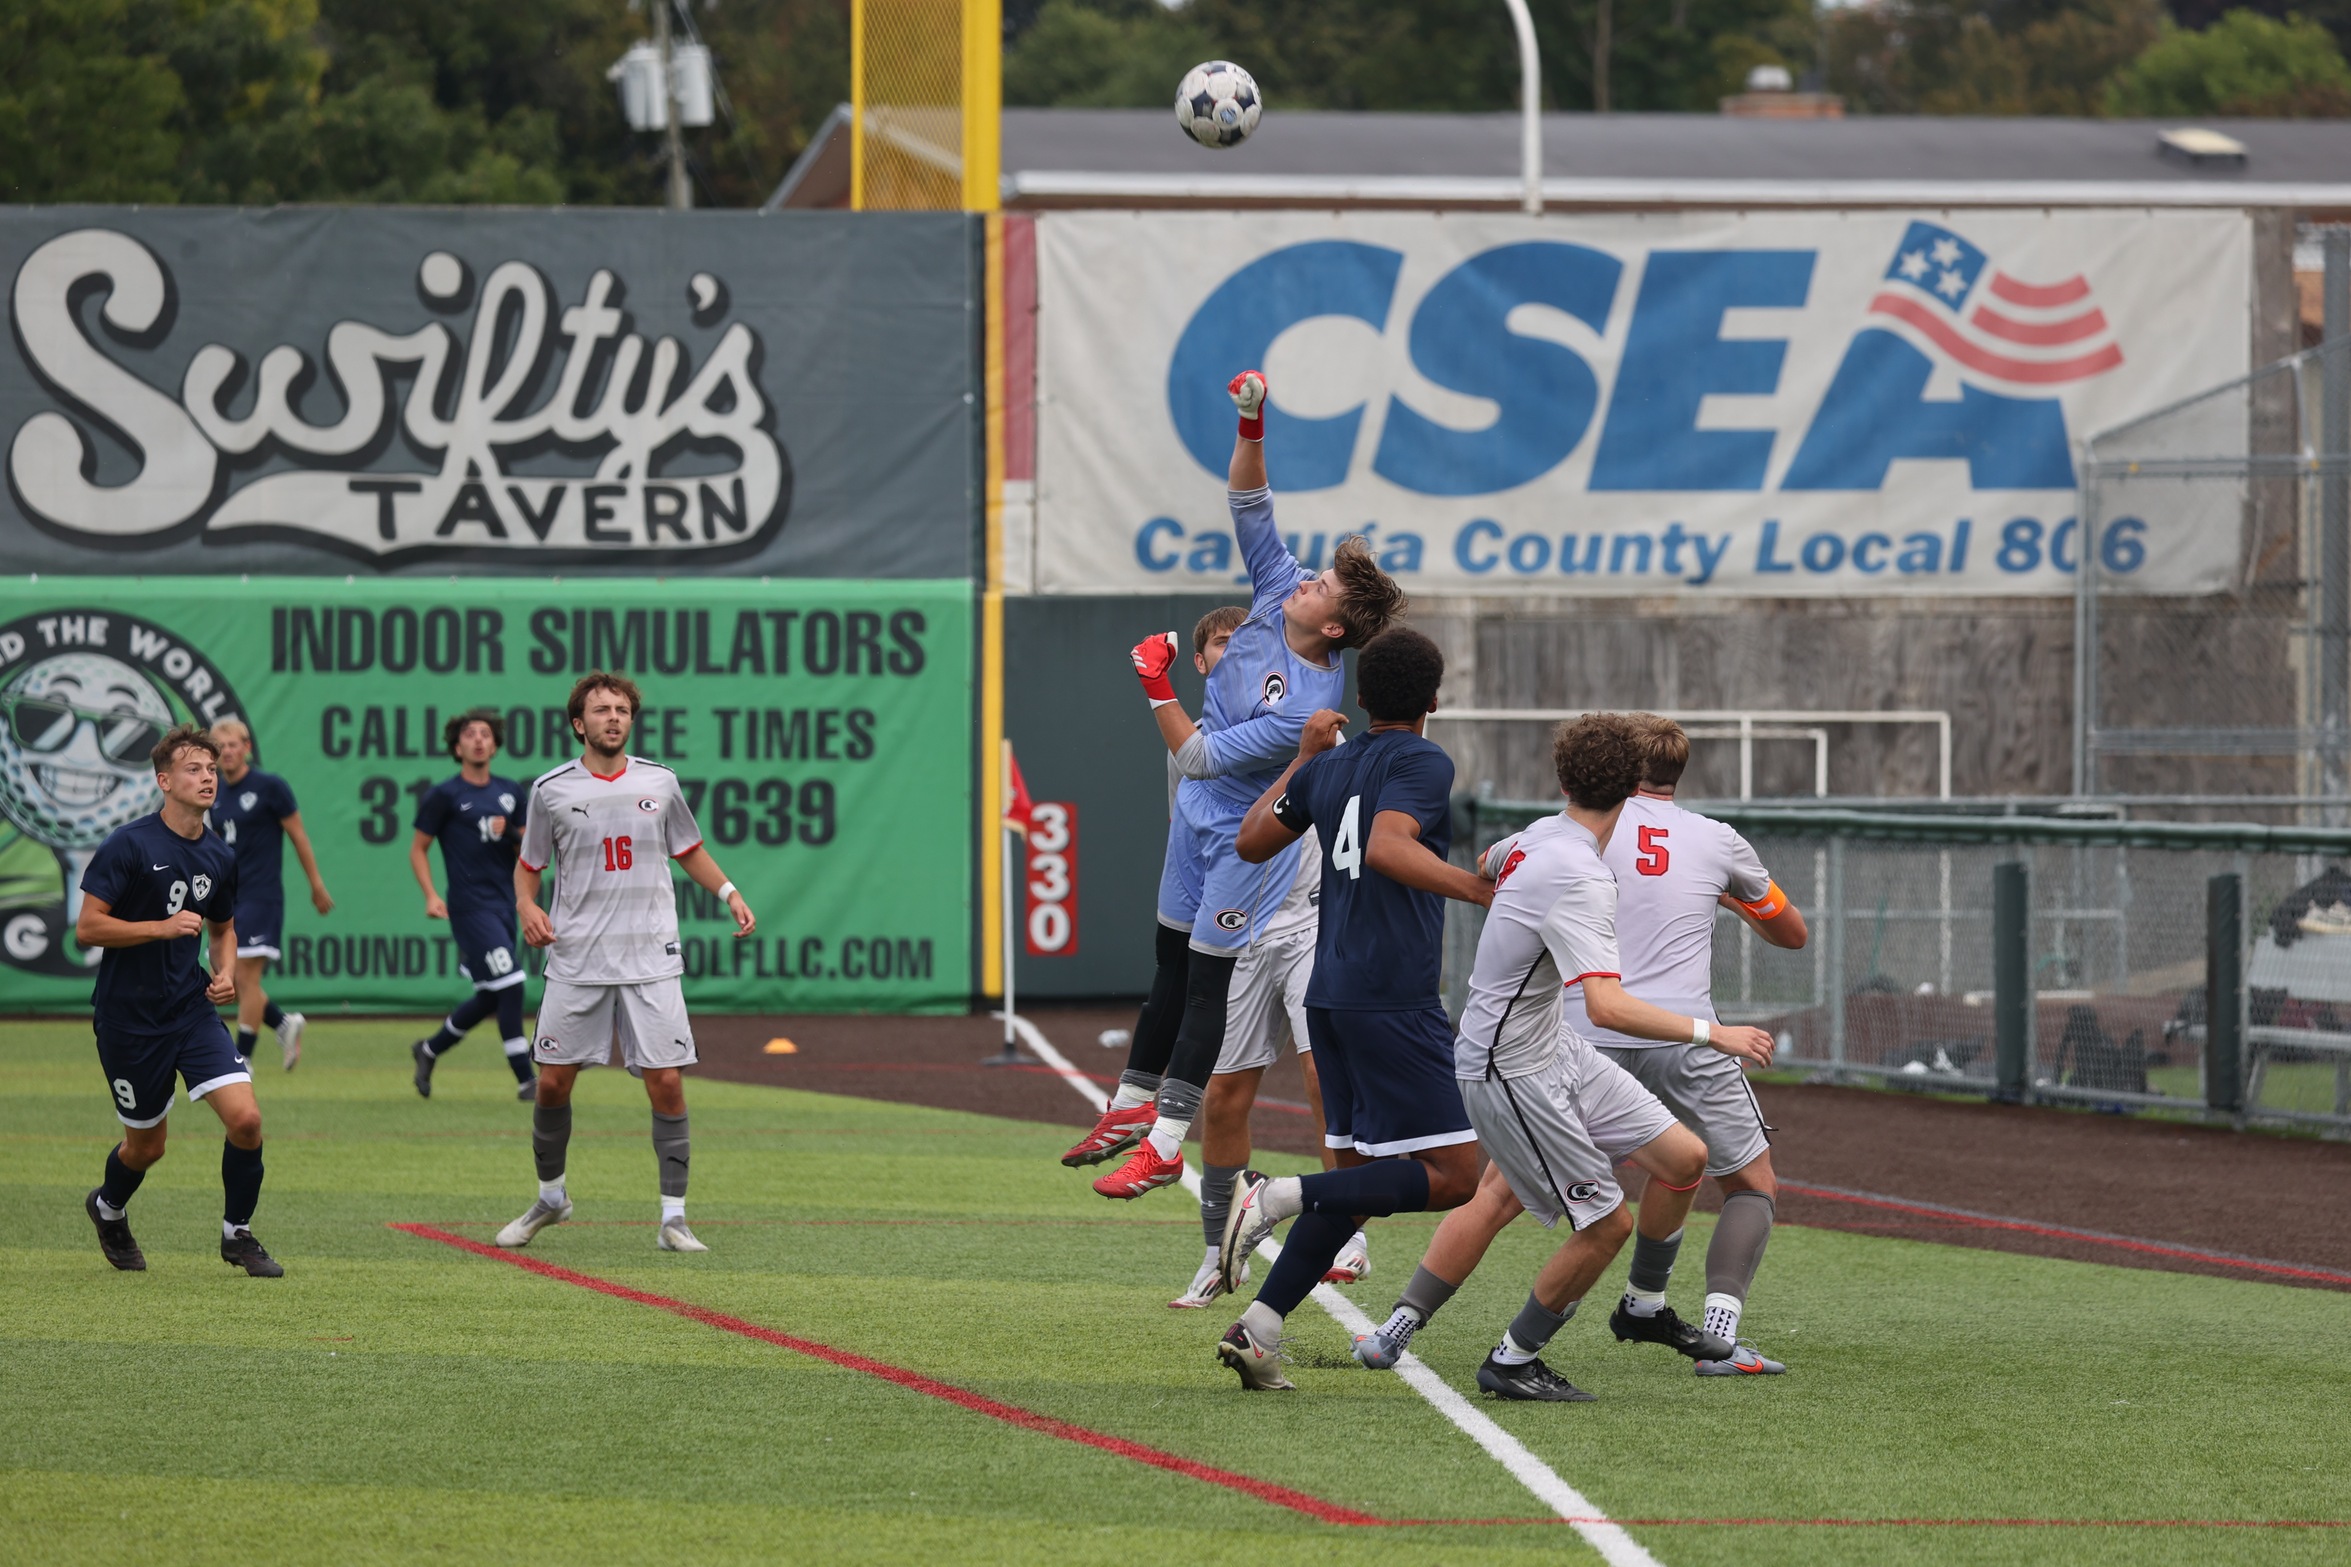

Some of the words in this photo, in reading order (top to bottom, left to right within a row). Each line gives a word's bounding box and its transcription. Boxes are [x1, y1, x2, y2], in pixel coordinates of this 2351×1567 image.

[12, 228, 768, 536] Swifty's
[1168, 238, 2078, 497] CSEA
[348, 478, 749, 543] TAVERN
[1455, 518, 1731, 583] County
[1756, 519, 1972, 574] Local
[1995, 517, 2146, 574] 806
[37, 615, 109, 648] THE
[129, 622, 241, 726] WORL
[271, 605, 505, 676] INDOOR
[528, 607, 927, 679] SIMULATORS
[320, 704, 450, 760] CALL
[712, 707, 876, 762] TIMES
[603, 835, 633, 872] 16
[1332, 794, 1362, 880] 4
[1635, 825, 1670, 876] 5
[166, 880, 189, 916] 9
[1030, 802, 1072, 952] 330
[485, 946, 514, 977] 18
[113, 1078, 137, 1110] 9
